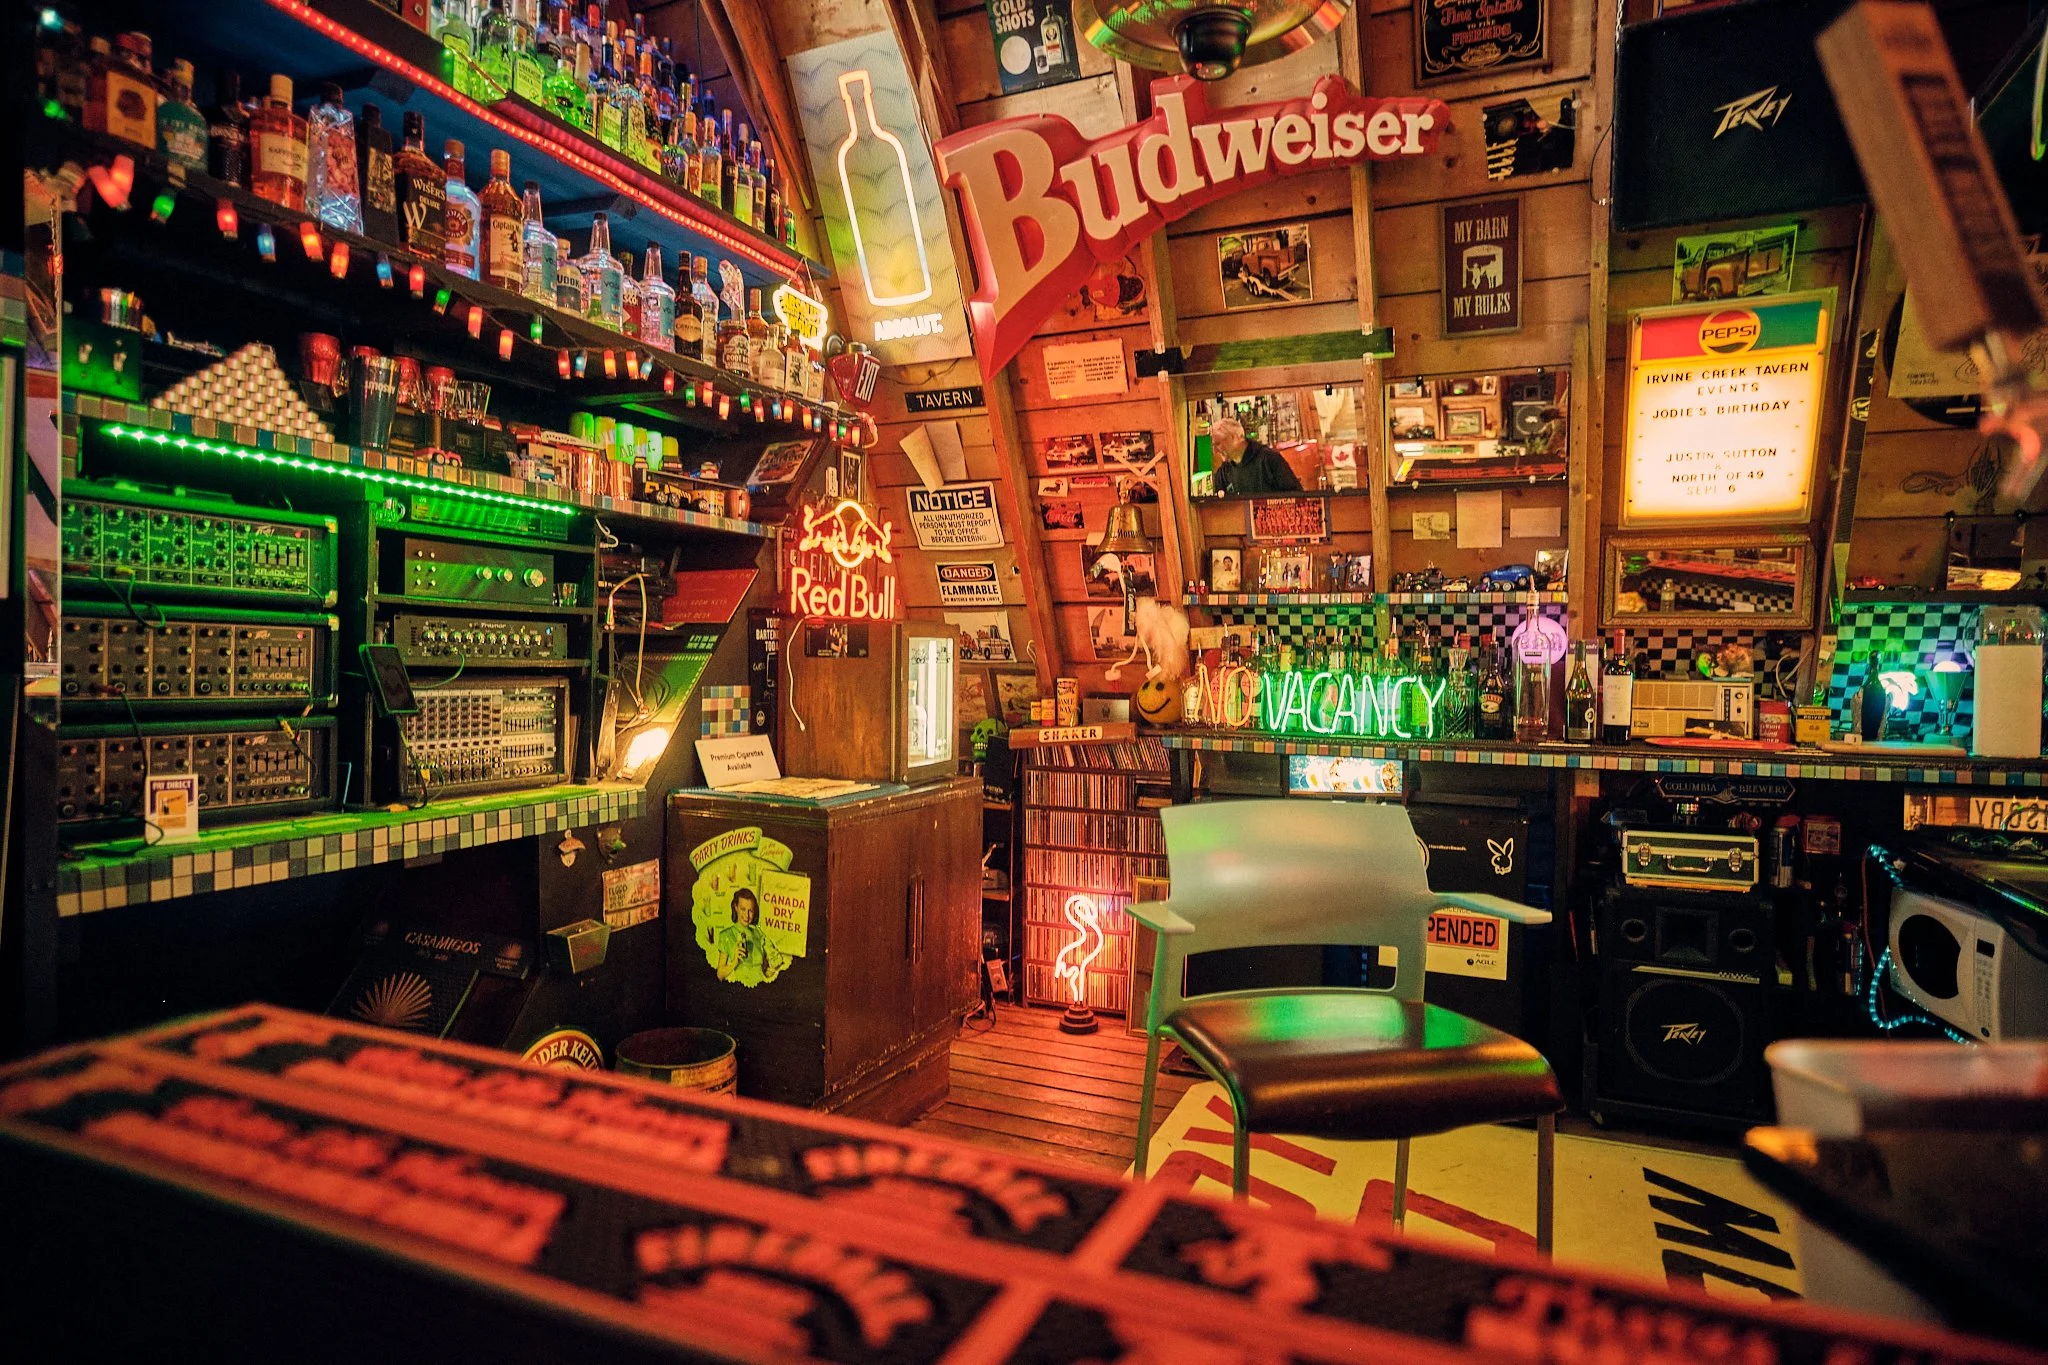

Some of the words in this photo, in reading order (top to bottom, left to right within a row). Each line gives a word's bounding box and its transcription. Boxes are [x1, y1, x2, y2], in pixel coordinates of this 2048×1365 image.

[995, 8, 1035, 34] SHOTS
[403, 201, 427, 230] W
[941, 92, 1435, 326] Budweiser
[492, 219, 515, 231] Captain
[1454, 219, 1473, 243] MY
[1476, 216, 1509, 241] BARN
[1453, 296, 1472, 318] MY
[1475, 292, 1511, 316] RULES
[1701, 325, 1757, 341] PEPSI
[1646, 371, 1693, 384] IRVINE
[1702, 367, 1746, 380] CREEK
[1756, 362, 1809, 376] TAVERN
[855, 360, 880, 402] EXIT
[1697, 383, 1759, 396] EVENTS
[916, 390, 973, 409] TAVERN
[1717, 400, 1791, 415] BIRTHDAY
[1666, 451, 1714, 463] JUSTIN
[1723, 448, 1777, 459] SUTTON
[1672, 473, 1717, 483] NORTH
[1726, 471, 1742, 481] OF
[1747, 471, 1765, 480] 49
[1728, 484, 1736, 493] 6
[916, 490, 987, 511] NOTICE
[919, 522, 947, 530] PERSONS
[967, 519, 992, 527] REPORT
[923, 514, 934, 522] ALL
[936, 512, 984, 522] UNAUTHORIZED
[944, 567, 989, 579] DANGER
[791, 567, 848, 617] Red
[850, 573, 895, 620] Bull
[941, 584, 999, 596] FLAMMABLE
[1195, 664, 1254, 727] NO
[1263, 671, 1446, 739] VACANCY
[1043, 728, 1097, 741] SHAKER
[710, 752, 736, 762] Premium
[736, 749, 764, 761] Cigarettes
[727, 763, 752, 772] Available
[166, 780, 191, 790] DIRECT
[1665, 782, 1717, 793] COLUMBIA
[1739, 784, 1788, 795] BREWERY
[692, 840, 718, 866] PARTY
[721, 830, 756, 850] DRINKS
[763, 892, 806, 909] CANADA
[773, 907, 794, 919] DRY
[765, 917, 802, 934] WATER
[405, 931, 482, 955] CASAMIGOS
